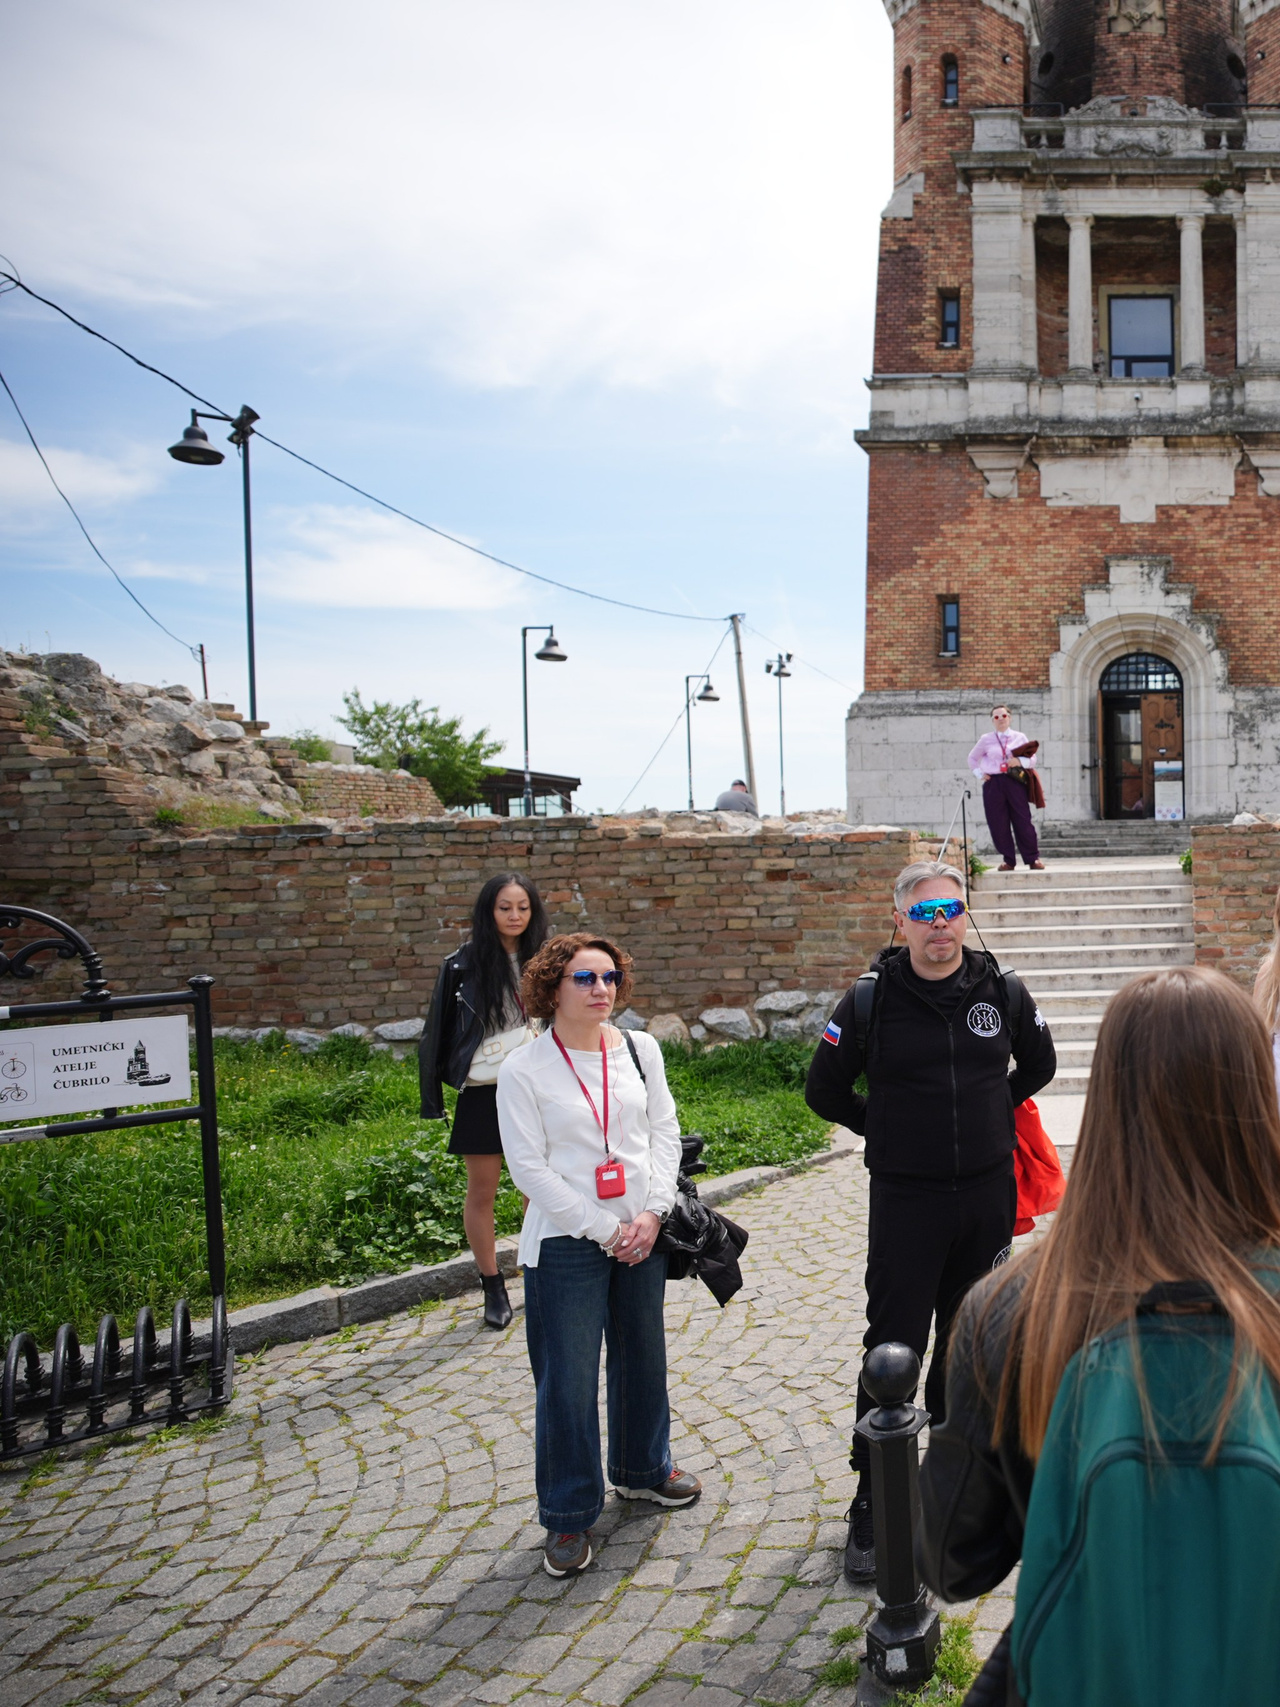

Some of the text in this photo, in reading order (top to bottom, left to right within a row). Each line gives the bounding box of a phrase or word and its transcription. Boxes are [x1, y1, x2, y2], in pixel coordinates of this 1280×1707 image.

[52, 1042, 125, 1057] UMETNIČKI
[53, 1061, 97, 1073] ATELJE
[53, 1076, 110, 1090] ČUBRILO
